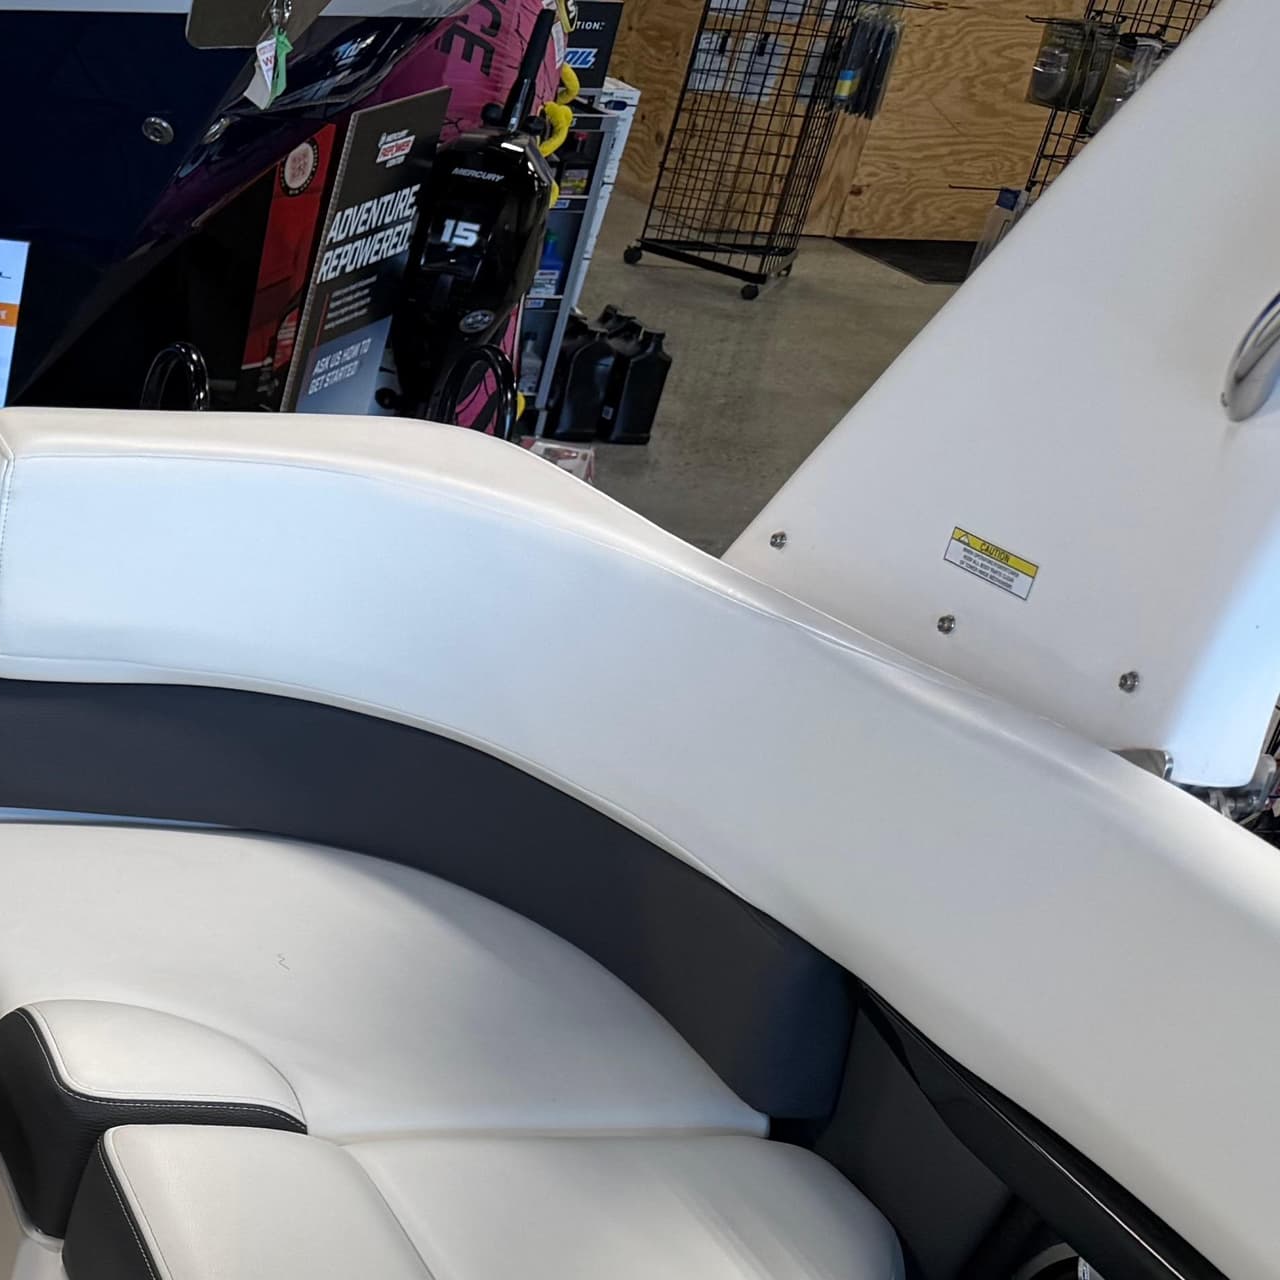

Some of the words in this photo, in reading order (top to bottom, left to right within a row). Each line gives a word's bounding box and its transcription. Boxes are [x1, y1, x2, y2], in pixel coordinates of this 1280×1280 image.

[451, 167, 505, 183] MERCURY
[326, 184, 421, 245] ADVENTURE,
[440, 218, 481, 248] 15
[316, 221, 413, 285] REPOWERED.
[980, 542, 1010, 563] CAUTION
